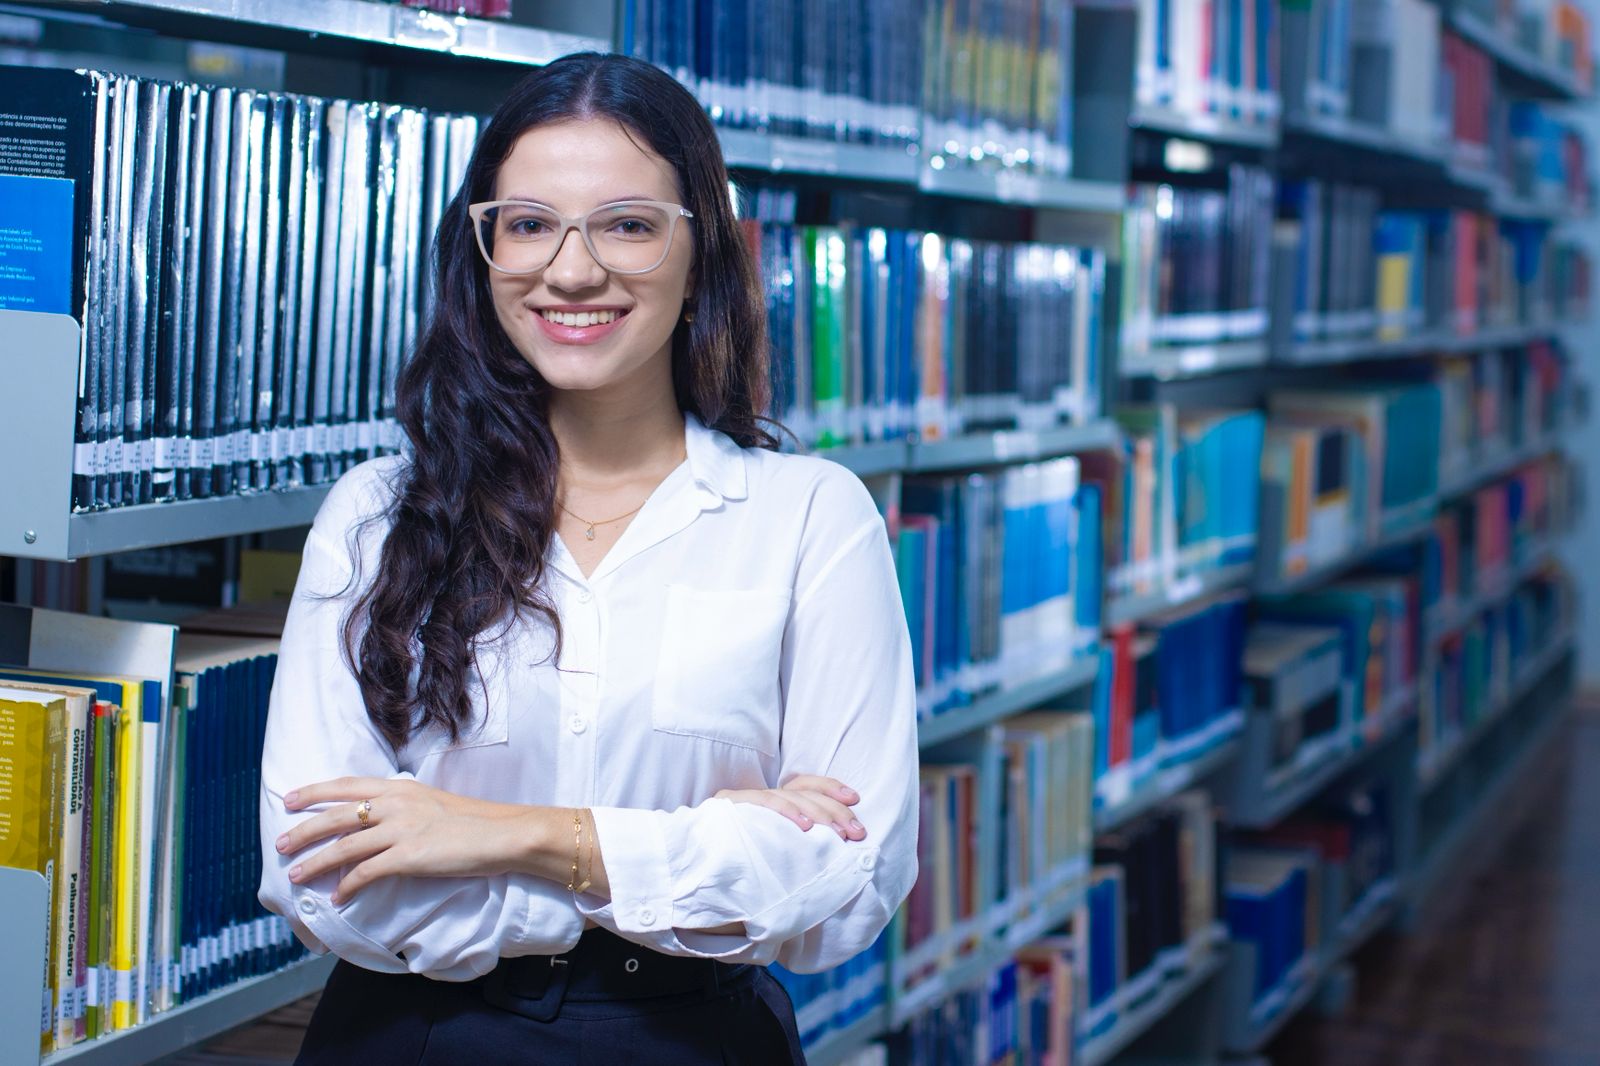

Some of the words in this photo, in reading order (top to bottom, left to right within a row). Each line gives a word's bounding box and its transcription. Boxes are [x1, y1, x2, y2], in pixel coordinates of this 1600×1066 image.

[15, 121, 51, 129] demonstrações
[20, 138, 54, 146] equipamentos
[7, 158, 40, 166] Contabilidade
[70, 729, 80, 815] CONTABILIDADE
[67, 873, 77, 977] Palhares/Castro
